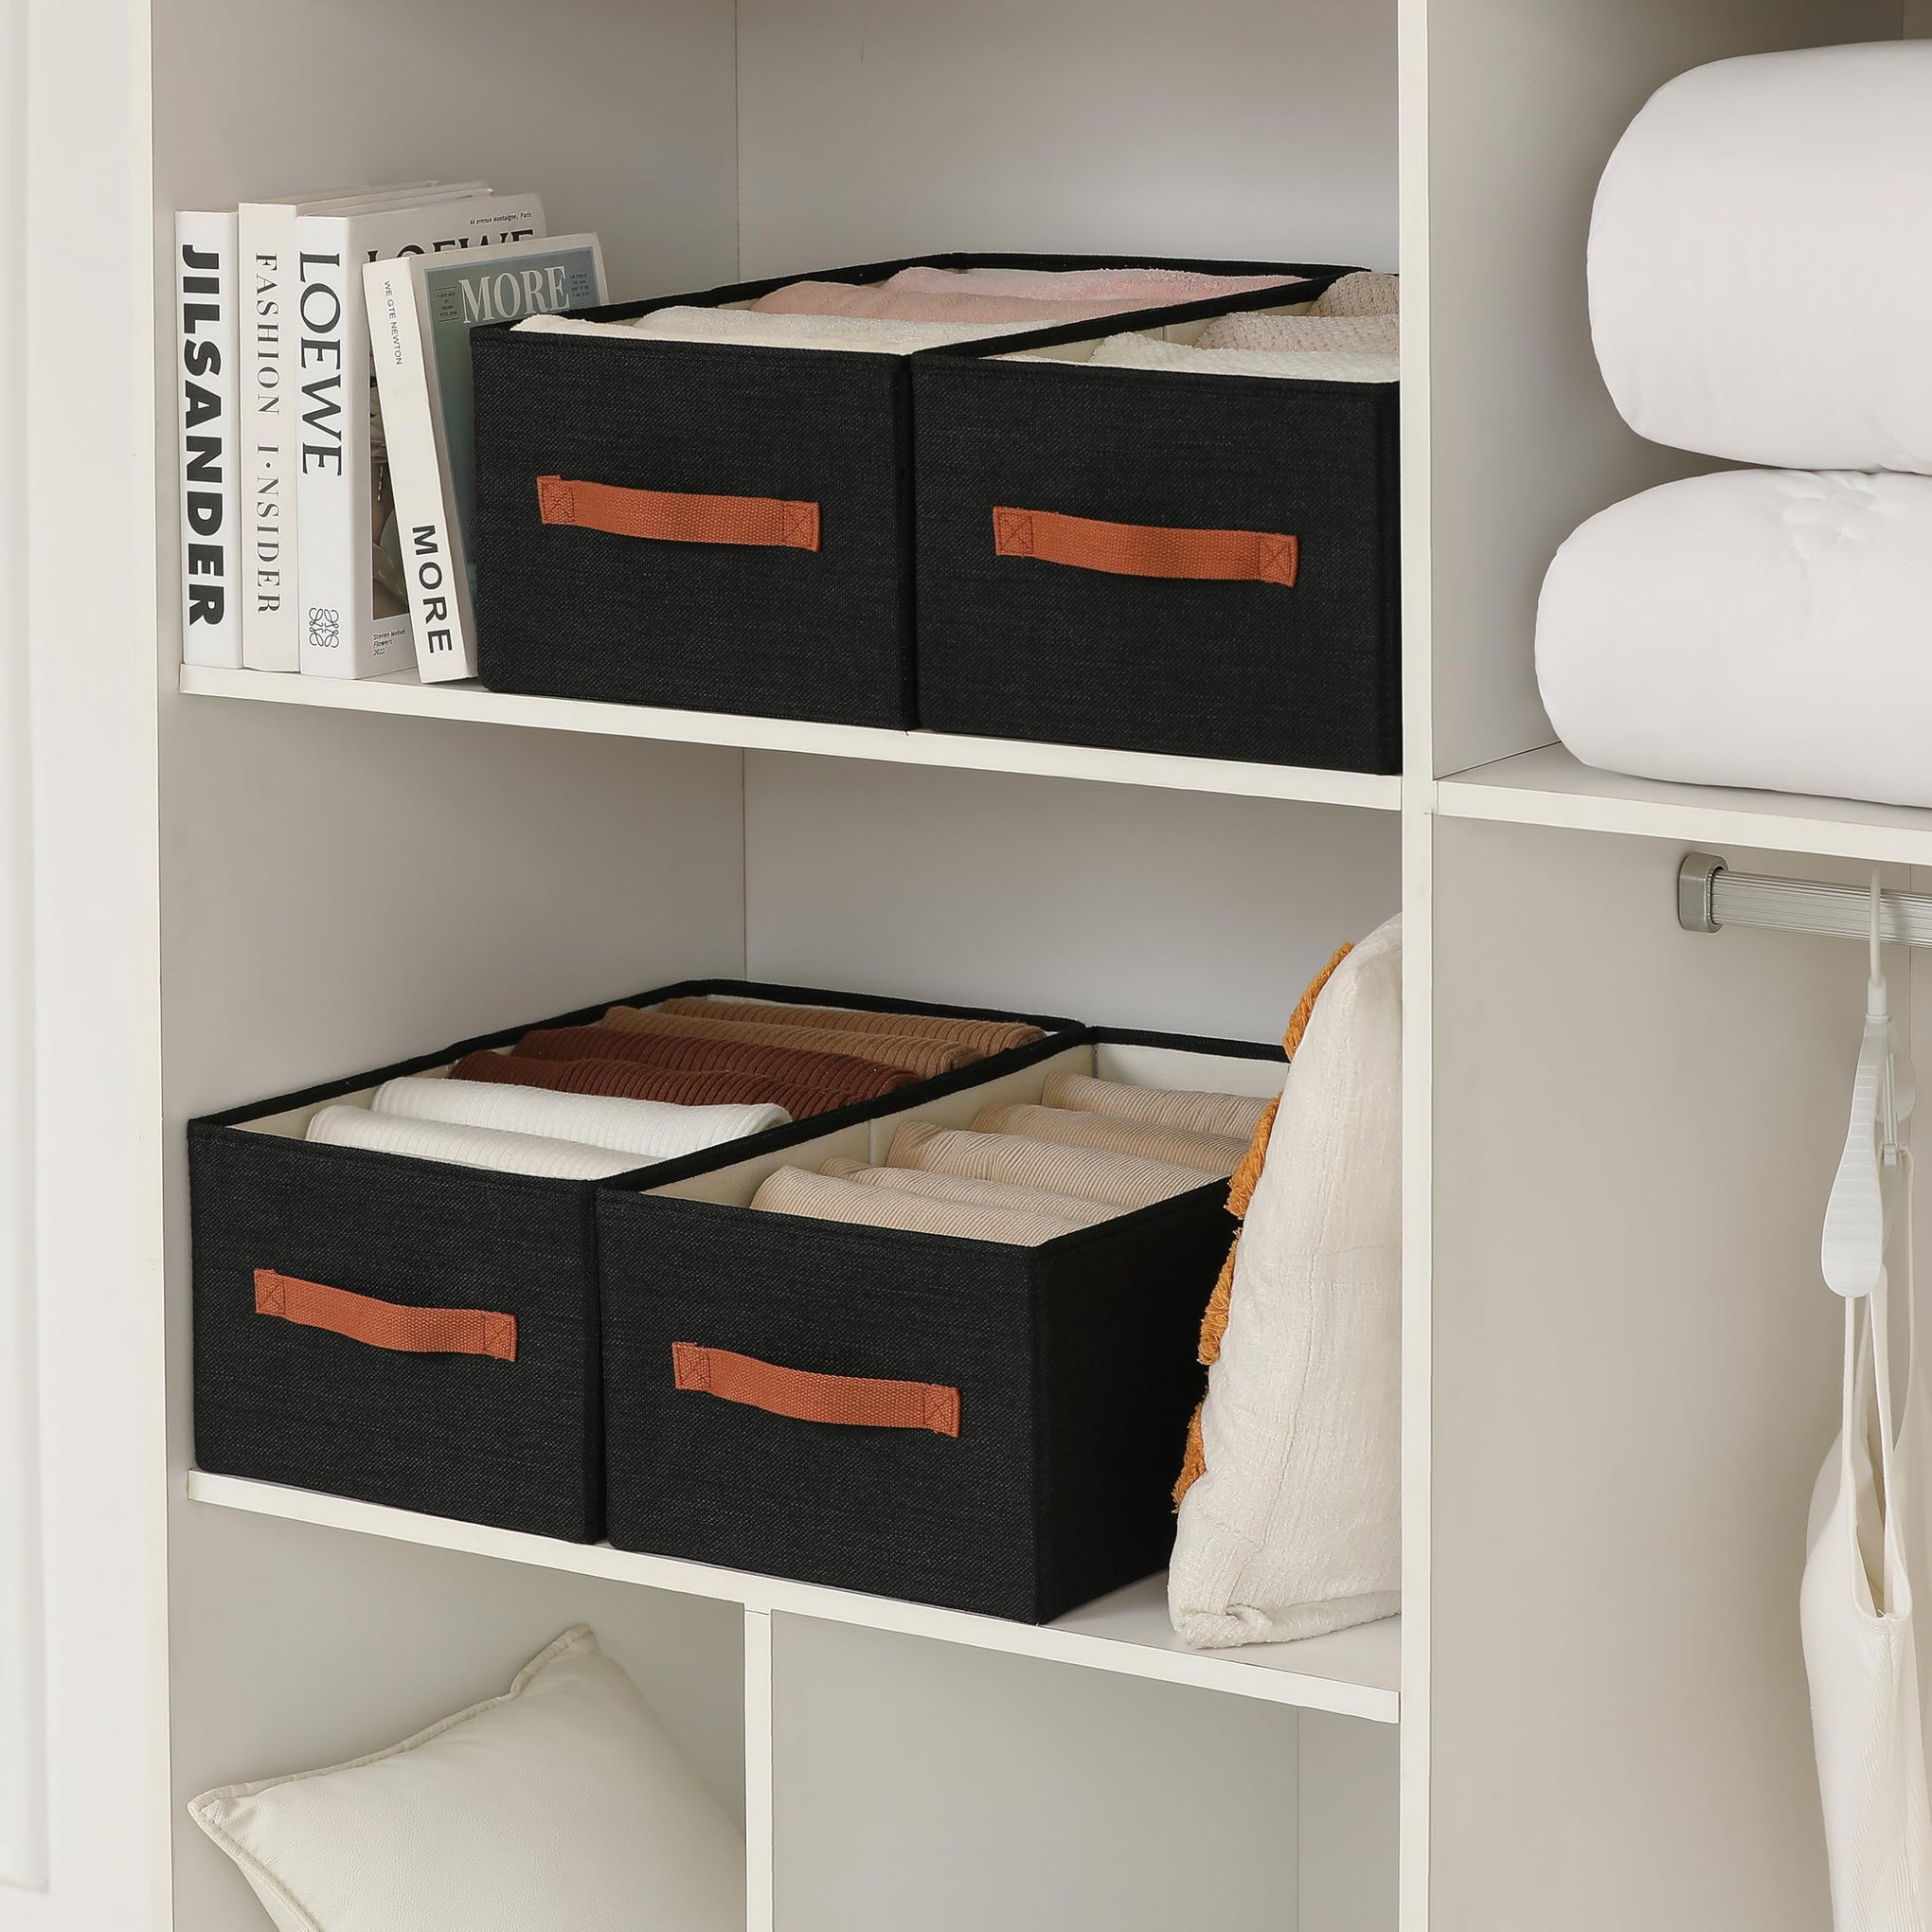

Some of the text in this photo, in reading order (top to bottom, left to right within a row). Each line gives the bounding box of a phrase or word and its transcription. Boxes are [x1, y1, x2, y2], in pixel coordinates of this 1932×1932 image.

[256, 252, 280, 415] FASHION
[299, 250, 342, 476] LOEWE
[384, 280, 402, 365] WE GTE NEWTON
[458, 265, 570, 325] MORE
[182, 244, 224, 627] JILSANDER
[412, 525, 453, 653] MORE
